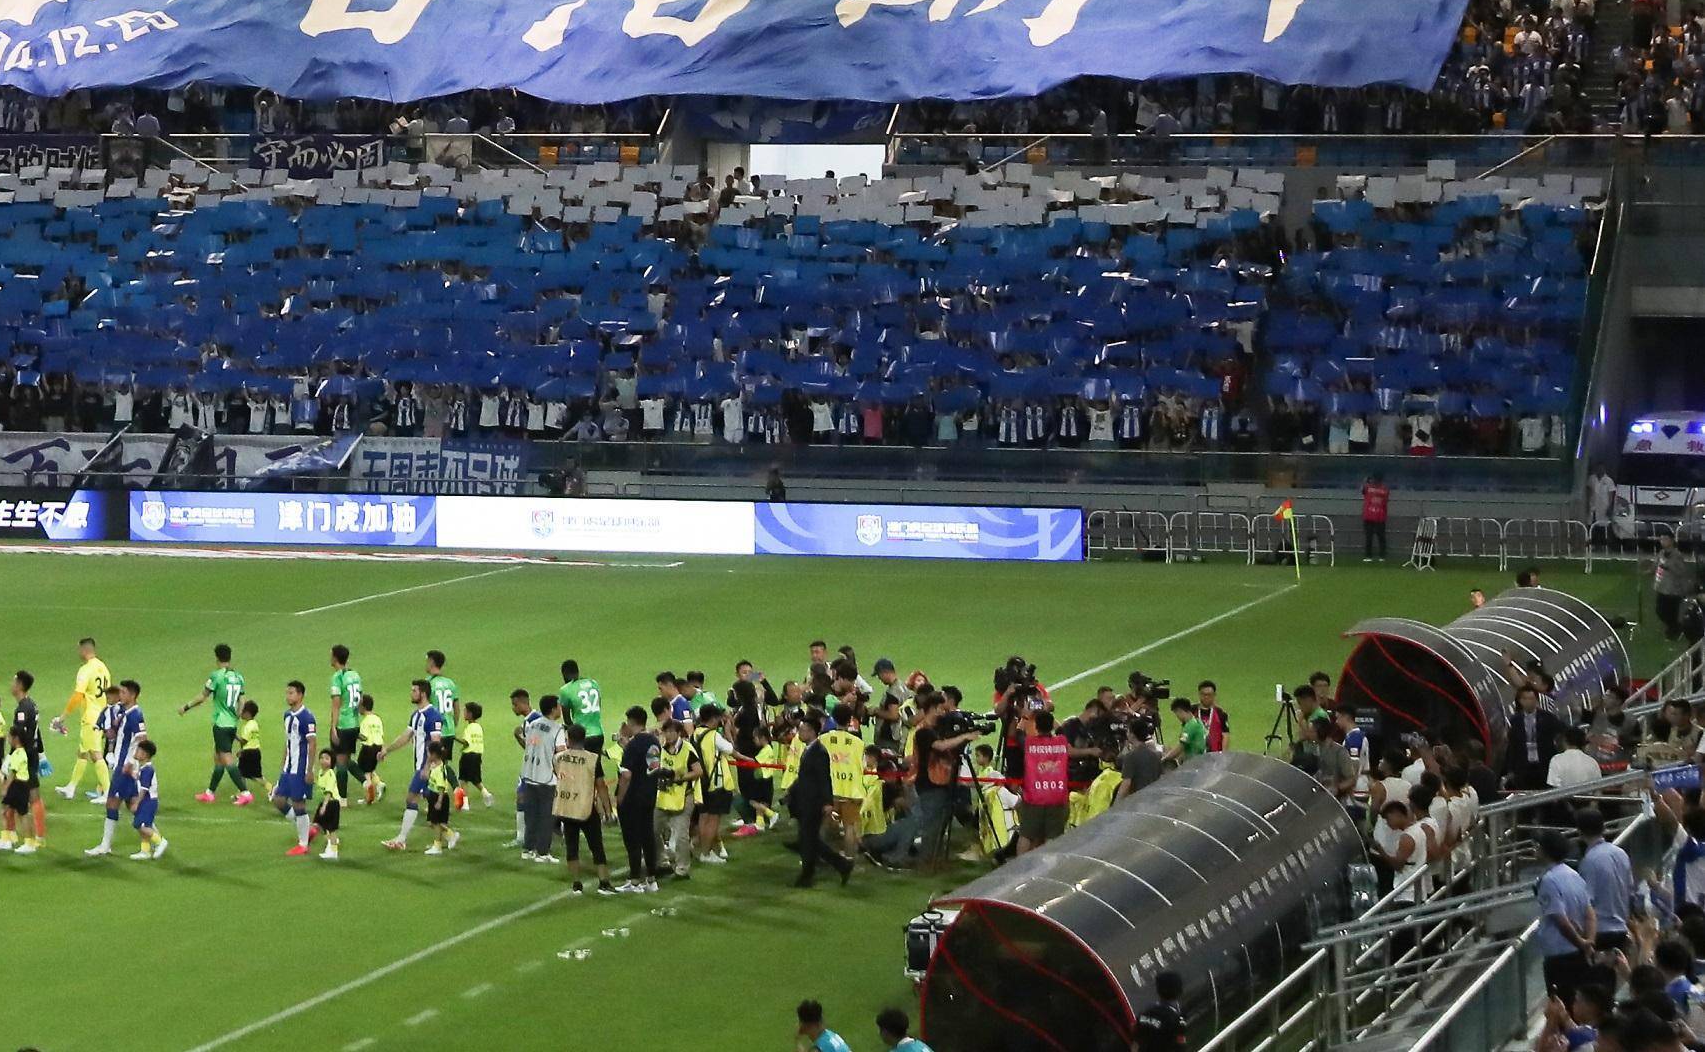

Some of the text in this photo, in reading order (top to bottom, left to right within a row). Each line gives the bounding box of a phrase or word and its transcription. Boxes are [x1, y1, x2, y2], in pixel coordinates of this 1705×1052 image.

[278, 500, 417, 535] 津门虎加油
[225, 684, 242, 707] 17
[346, 683, 361, 708] 15
[435, 689, 454, 713] 16
[577, 688, 600, 714] 32
[1035, 780, 1064, 790] 0802
